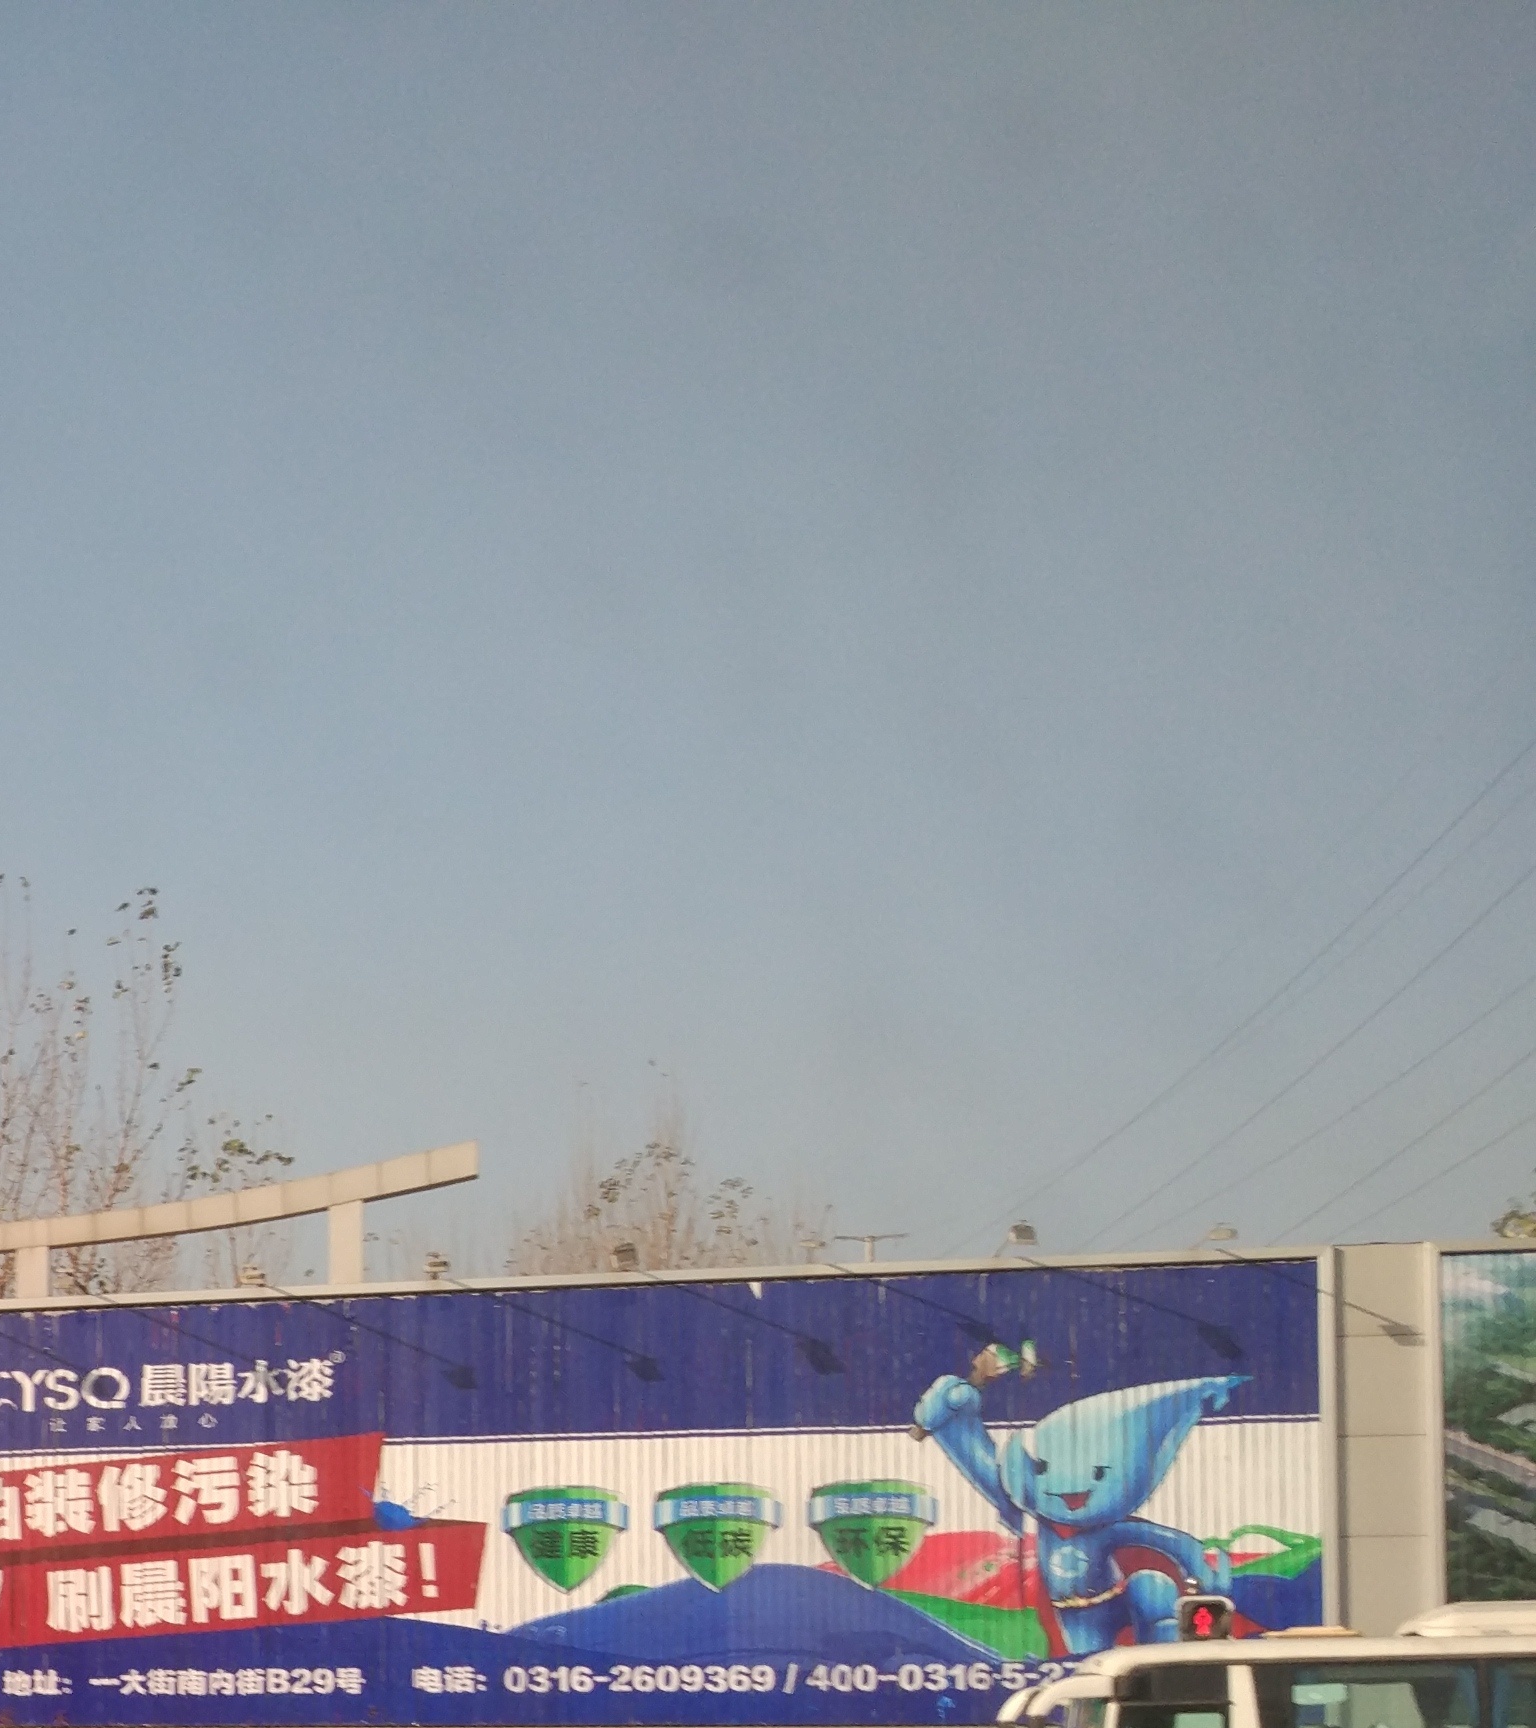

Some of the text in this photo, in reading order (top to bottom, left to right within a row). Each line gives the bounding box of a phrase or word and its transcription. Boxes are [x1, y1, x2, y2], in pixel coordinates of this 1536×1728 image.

[138, 1358, 335, 1407] 晨陽水漆
[532, 1529, 599, 1559] 健康
[683, 1527, 753, 1559] 低碳
[834, 1526, 910, 1557] 环保
[45, 1540, 439, 1633] 刷晨阳水漆！
